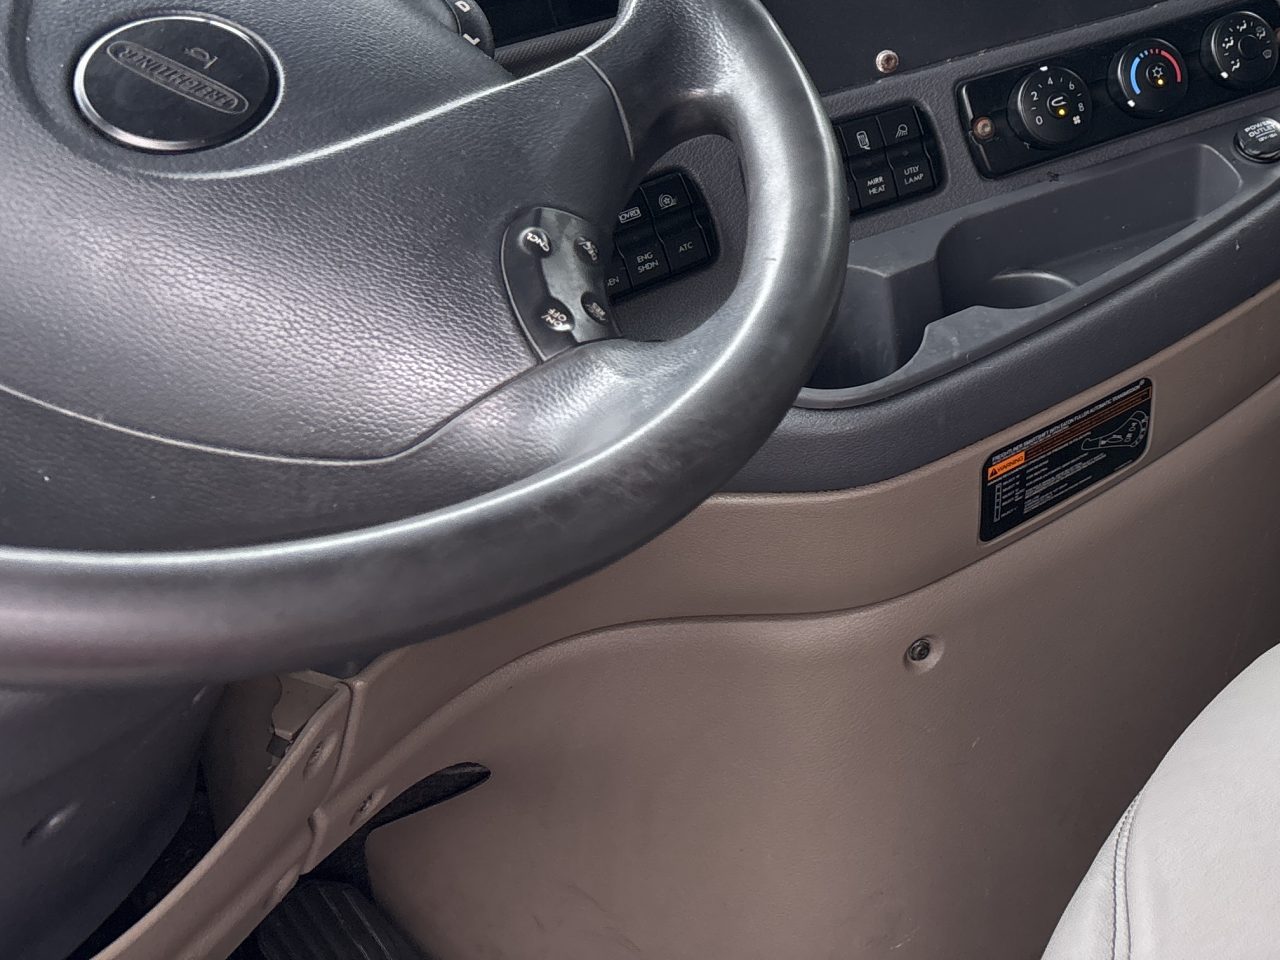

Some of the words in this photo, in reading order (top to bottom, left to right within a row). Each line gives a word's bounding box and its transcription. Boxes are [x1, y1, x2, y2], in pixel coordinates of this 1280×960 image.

[454, 0, 471, 13] D
[463, 33, 481, 46] L
[1068, 81, 1075, 90] 6
[1031, 91, 1039, 102] 2
[1077, 103, 1085, 112] 8
[904, 164, 920, 176] UTLY
[867, 176, 884, 187] MIRR
[904, 173, 924, 185] LAMP
[868, 184, 886, 195] HEAT
[678, 242, 694, 253] ATC
[637, 251, 654, 263] ENG
[637, 260, 659, 273] SHDN
[548, 308, 567, 322] OFF
